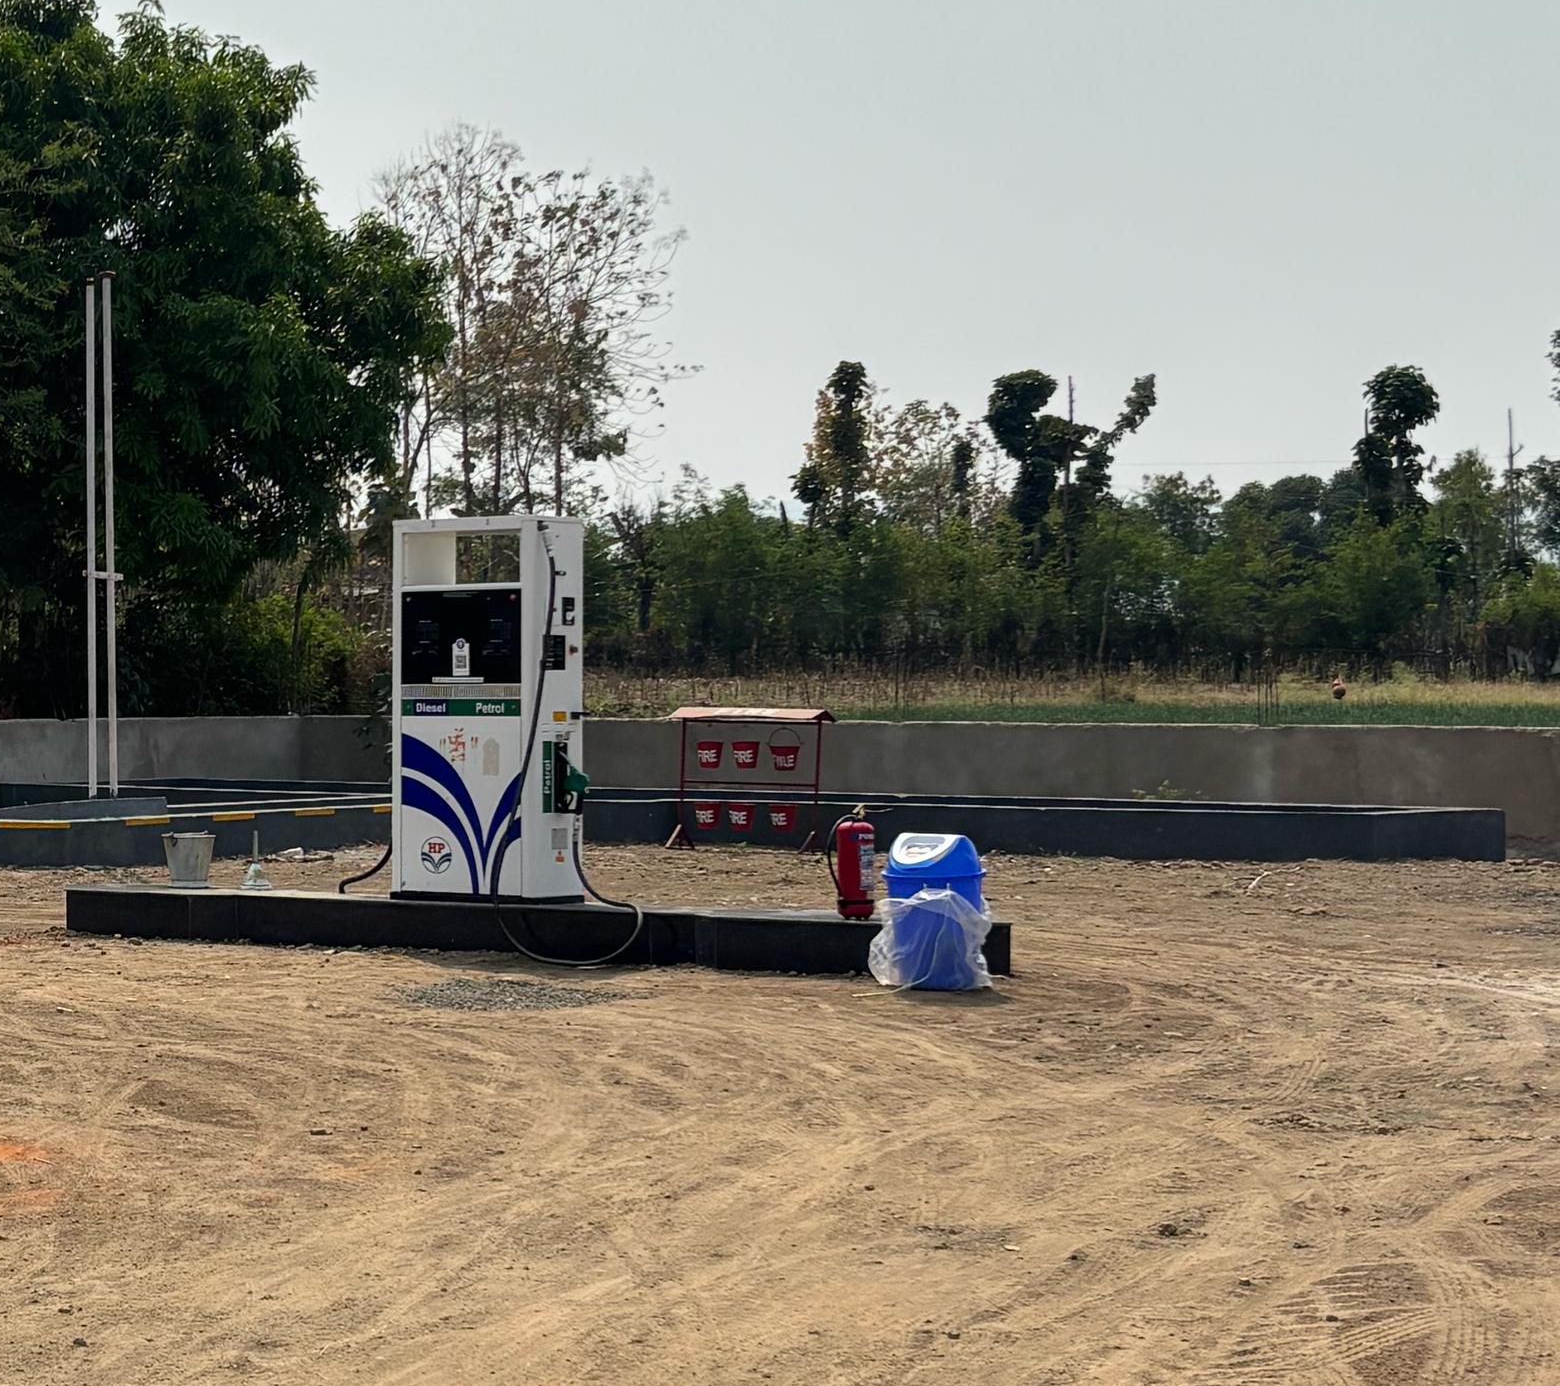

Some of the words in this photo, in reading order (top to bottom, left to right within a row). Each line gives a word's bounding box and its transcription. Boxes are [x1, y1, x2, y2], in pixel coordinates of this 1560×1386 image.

[416, 702, 446, 713] Diesel
[476, 702, 505, 714] Petrol
[697, 749, 718, 763] FIRE
[733, 749, 754, 763] FIRE
[543, 759, 551, 794] Petrol
[695, 810, 715, 824] FIRE
[729, 810, 748, 825] FIRE
[428, 842, 446, 854] HP
